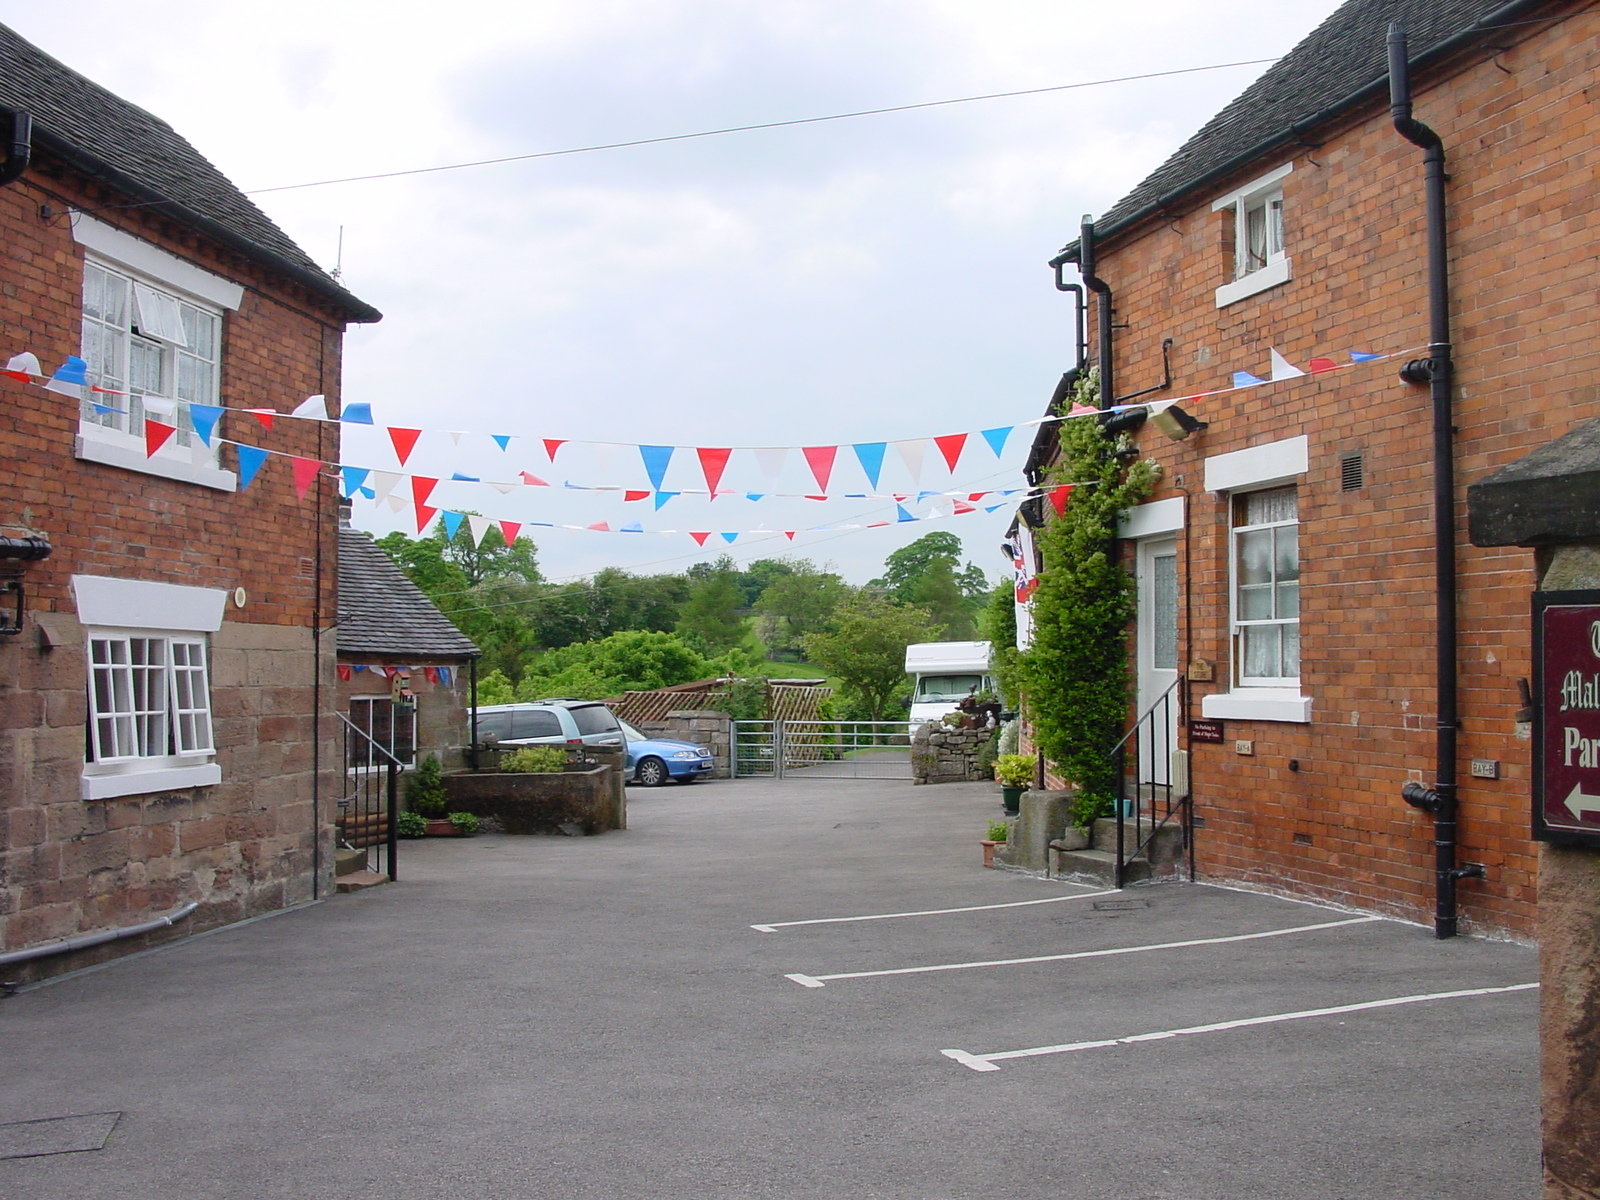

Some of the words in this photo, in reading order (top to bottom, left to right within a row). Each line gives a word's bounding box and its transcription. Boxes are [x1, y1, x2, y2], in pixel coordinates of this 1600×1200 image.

[1560, 670, 1600, 712] Mal
[1564, 727, 1600, 768] Par
[1473, 763, 1494, 774] BAY-B
